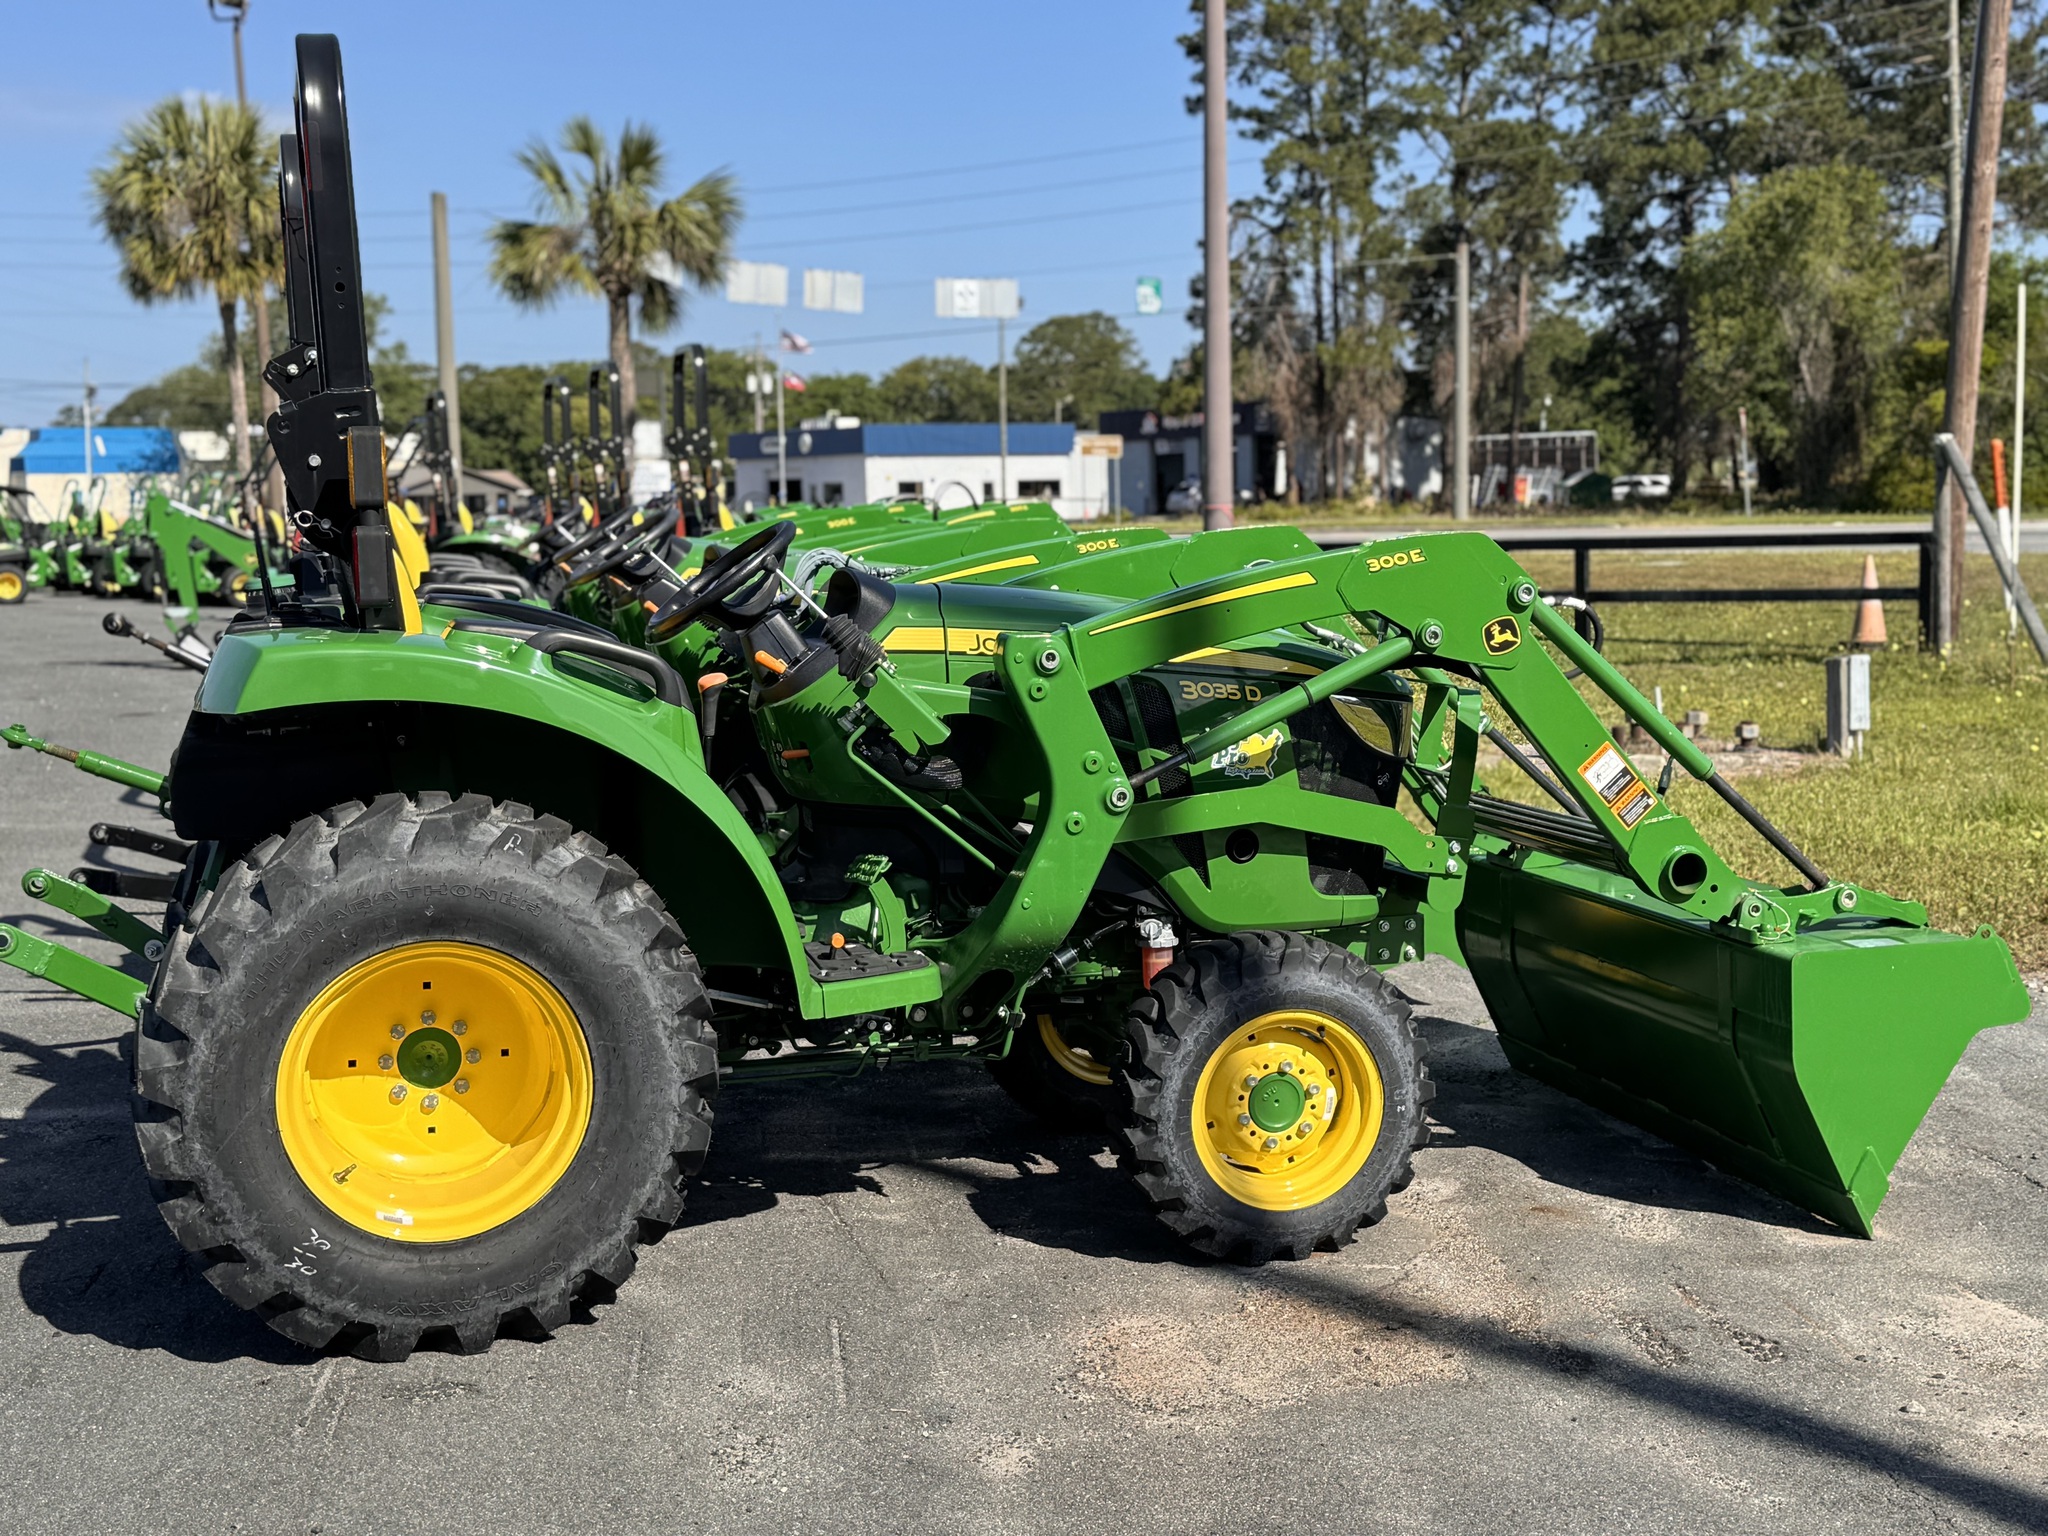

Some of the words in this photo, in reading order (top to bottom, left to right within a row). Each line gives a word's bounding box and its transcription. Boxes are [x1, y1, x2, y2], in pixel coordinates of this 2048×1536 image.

[968, 633, 997, 653] JO
[299, 883, 544, 945] MARATHONER
[386, 1261, 566, 1317] GALAXY
